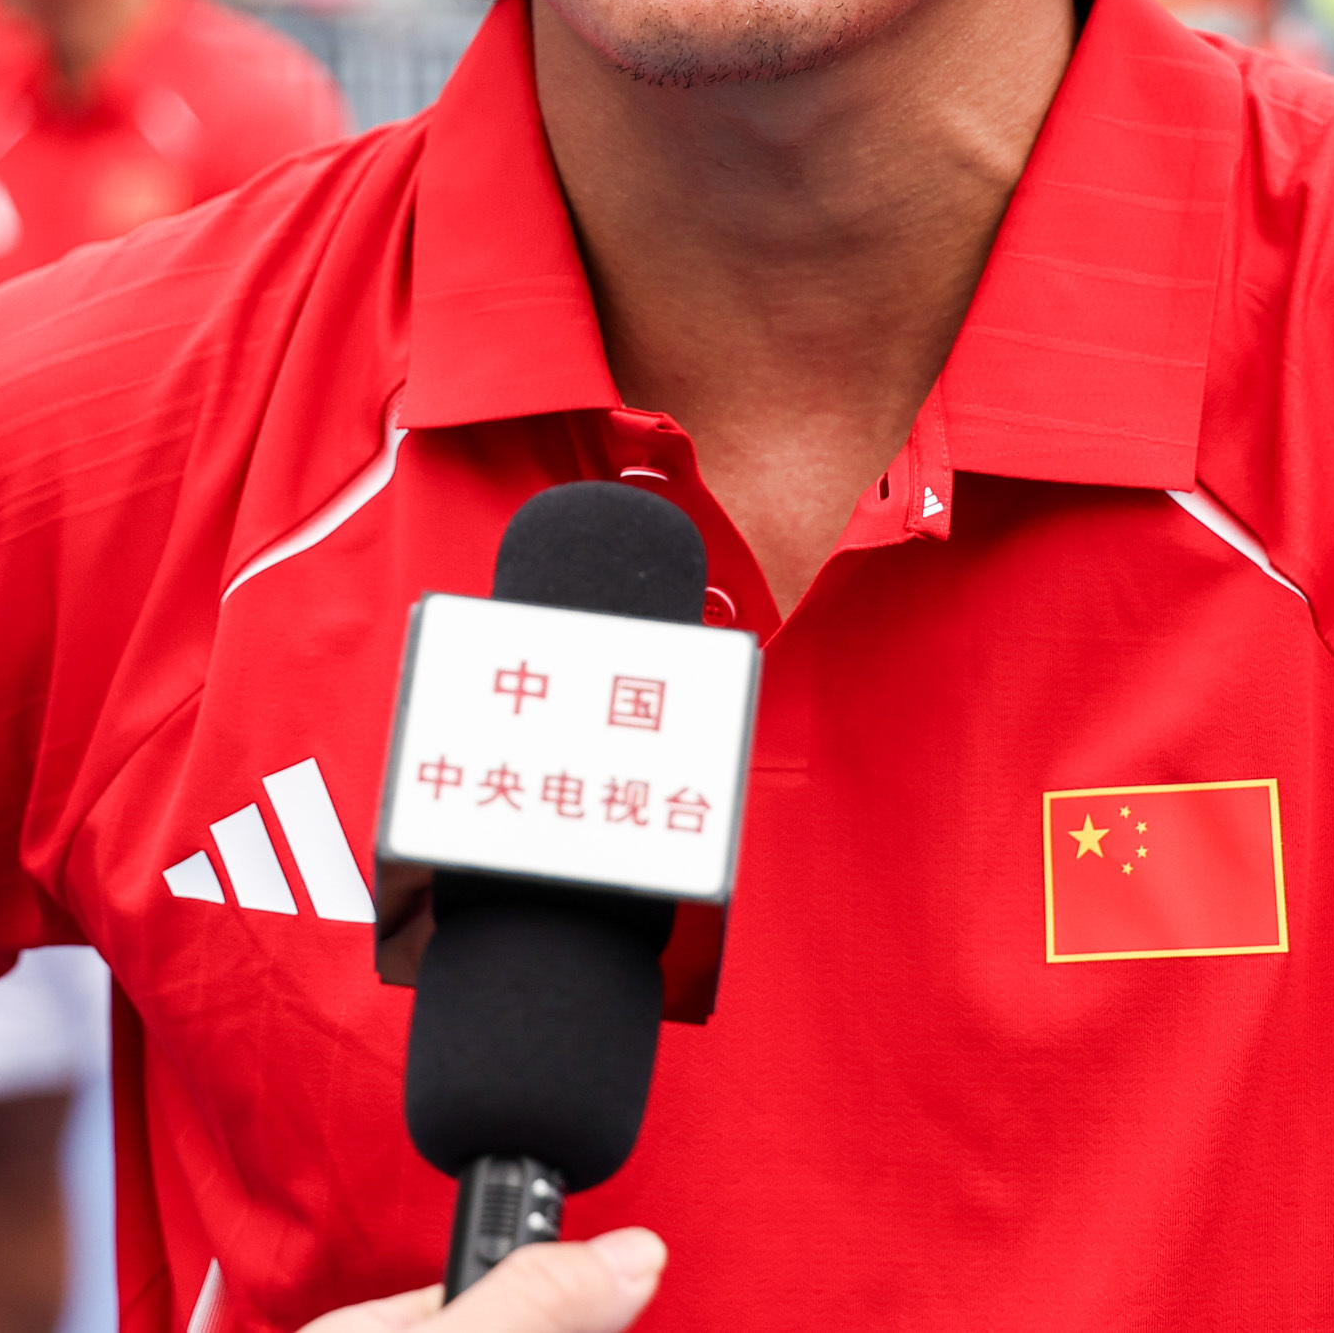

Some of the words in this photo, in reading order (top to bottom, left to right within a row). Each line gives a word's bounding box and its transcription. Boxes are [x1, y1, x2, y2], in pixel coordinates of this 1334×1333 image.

[493, 661, 667, 732] 中国
[417, 755, 712, 834] 中央电视台
